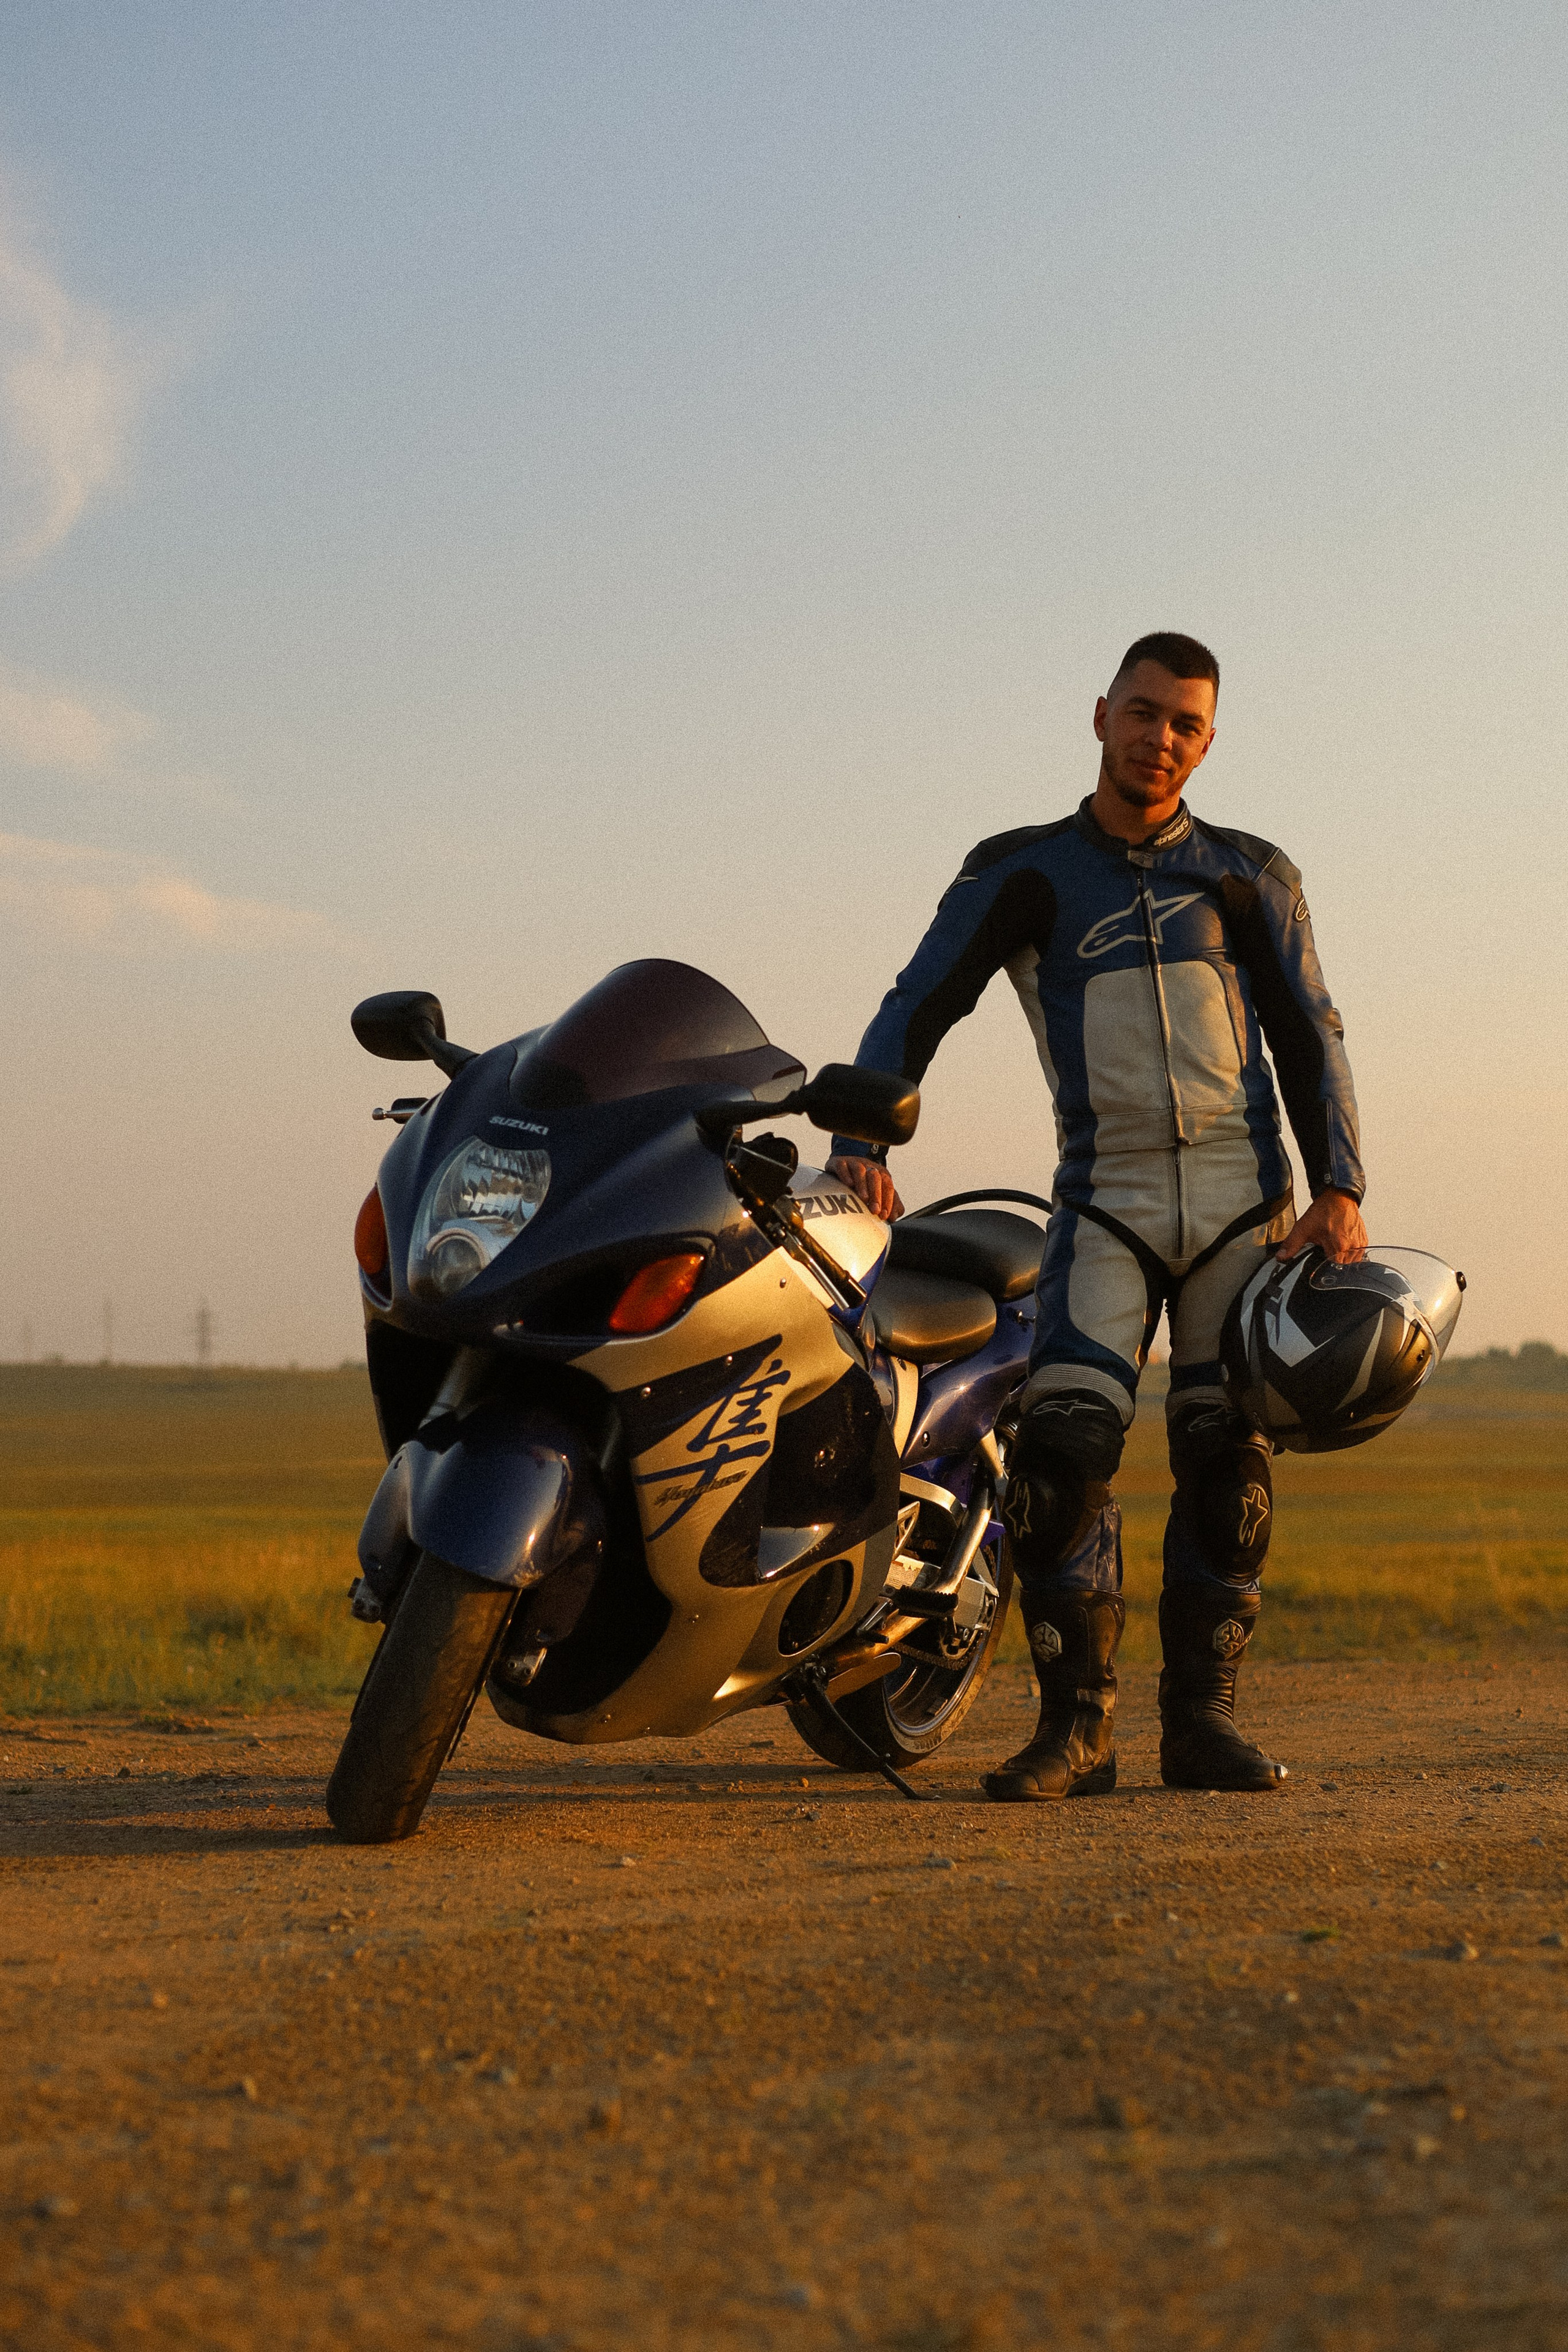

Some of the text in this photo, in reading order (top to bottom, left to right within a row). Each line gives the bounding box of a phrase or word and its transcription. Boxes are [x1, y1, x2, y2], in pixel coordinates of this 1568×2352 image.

[1154, 818, 1189, 846] alpinestars
[489, 1116, 549, 1136] SUZUKI
[796, 1194, 864, 1221] ZUKI
